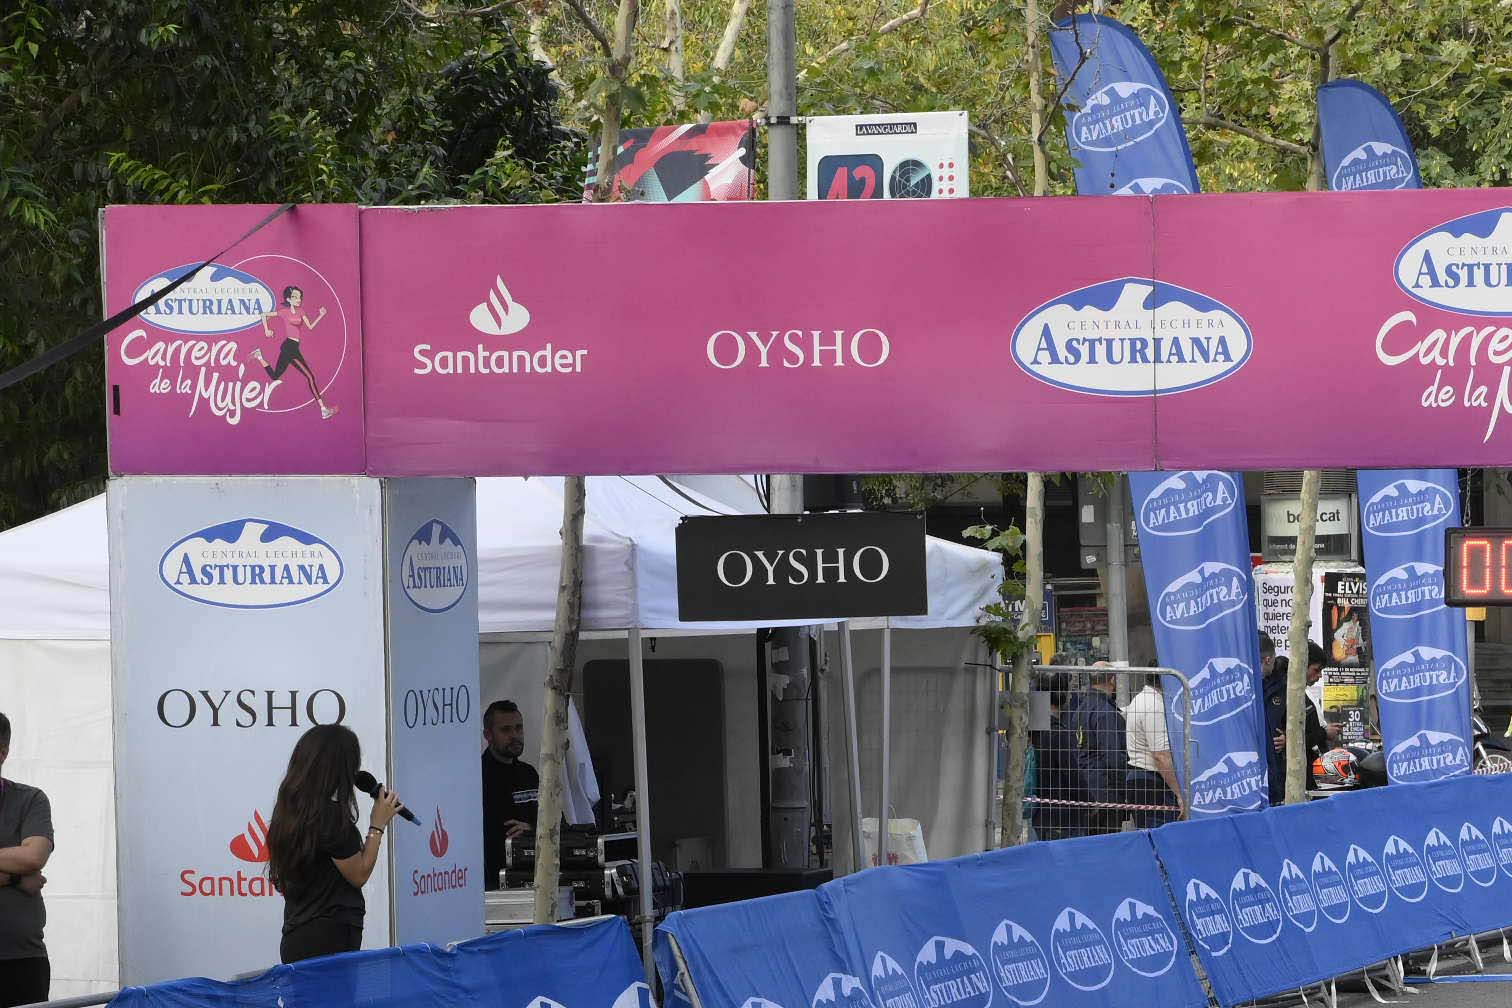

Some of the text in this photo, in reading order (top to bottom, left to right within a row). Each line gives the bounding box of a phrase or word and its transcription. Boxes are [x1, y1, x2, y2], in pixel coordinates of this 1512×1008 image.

[214, 287, 260, 295] LECHERA
[1067, 317, 1227, 331] CENTRAL LECHERA
[120, 329, 239, 366] Carrera
[413, 343, 587, 374] Santander
[706, 327, 890, 369] OYSHO
[1029, 322, 1234, 366] ASTURIANA
[150, 363, 283, 425] de la Mujer
[1421, 369, 1456, 408] de
[1464, 369, 1488, 408] la
[174, 551, 330, 587] ASTURIANA
[201, 550, 324, 559] CENTRAL LECHERA
[717, 545, 890, 587] OYSHO
[406, 555, 465, 591] ASTURIANA
[1338, 581, 1368, 594] ELVIS
[1263, 599, 1280, 609] que
[1263, 610, 1295, 623] quiere
[157, 688, 346, 728] OYSHO
[404, 684, 470, 729] OYSHO
[1348, 711, 1360, 721] 30
[412, 865, 468, 897] Santander
[996, 954, 1047, 987] ASTURIANA
[1057, 940, 1111, 973] ASTURIANA
